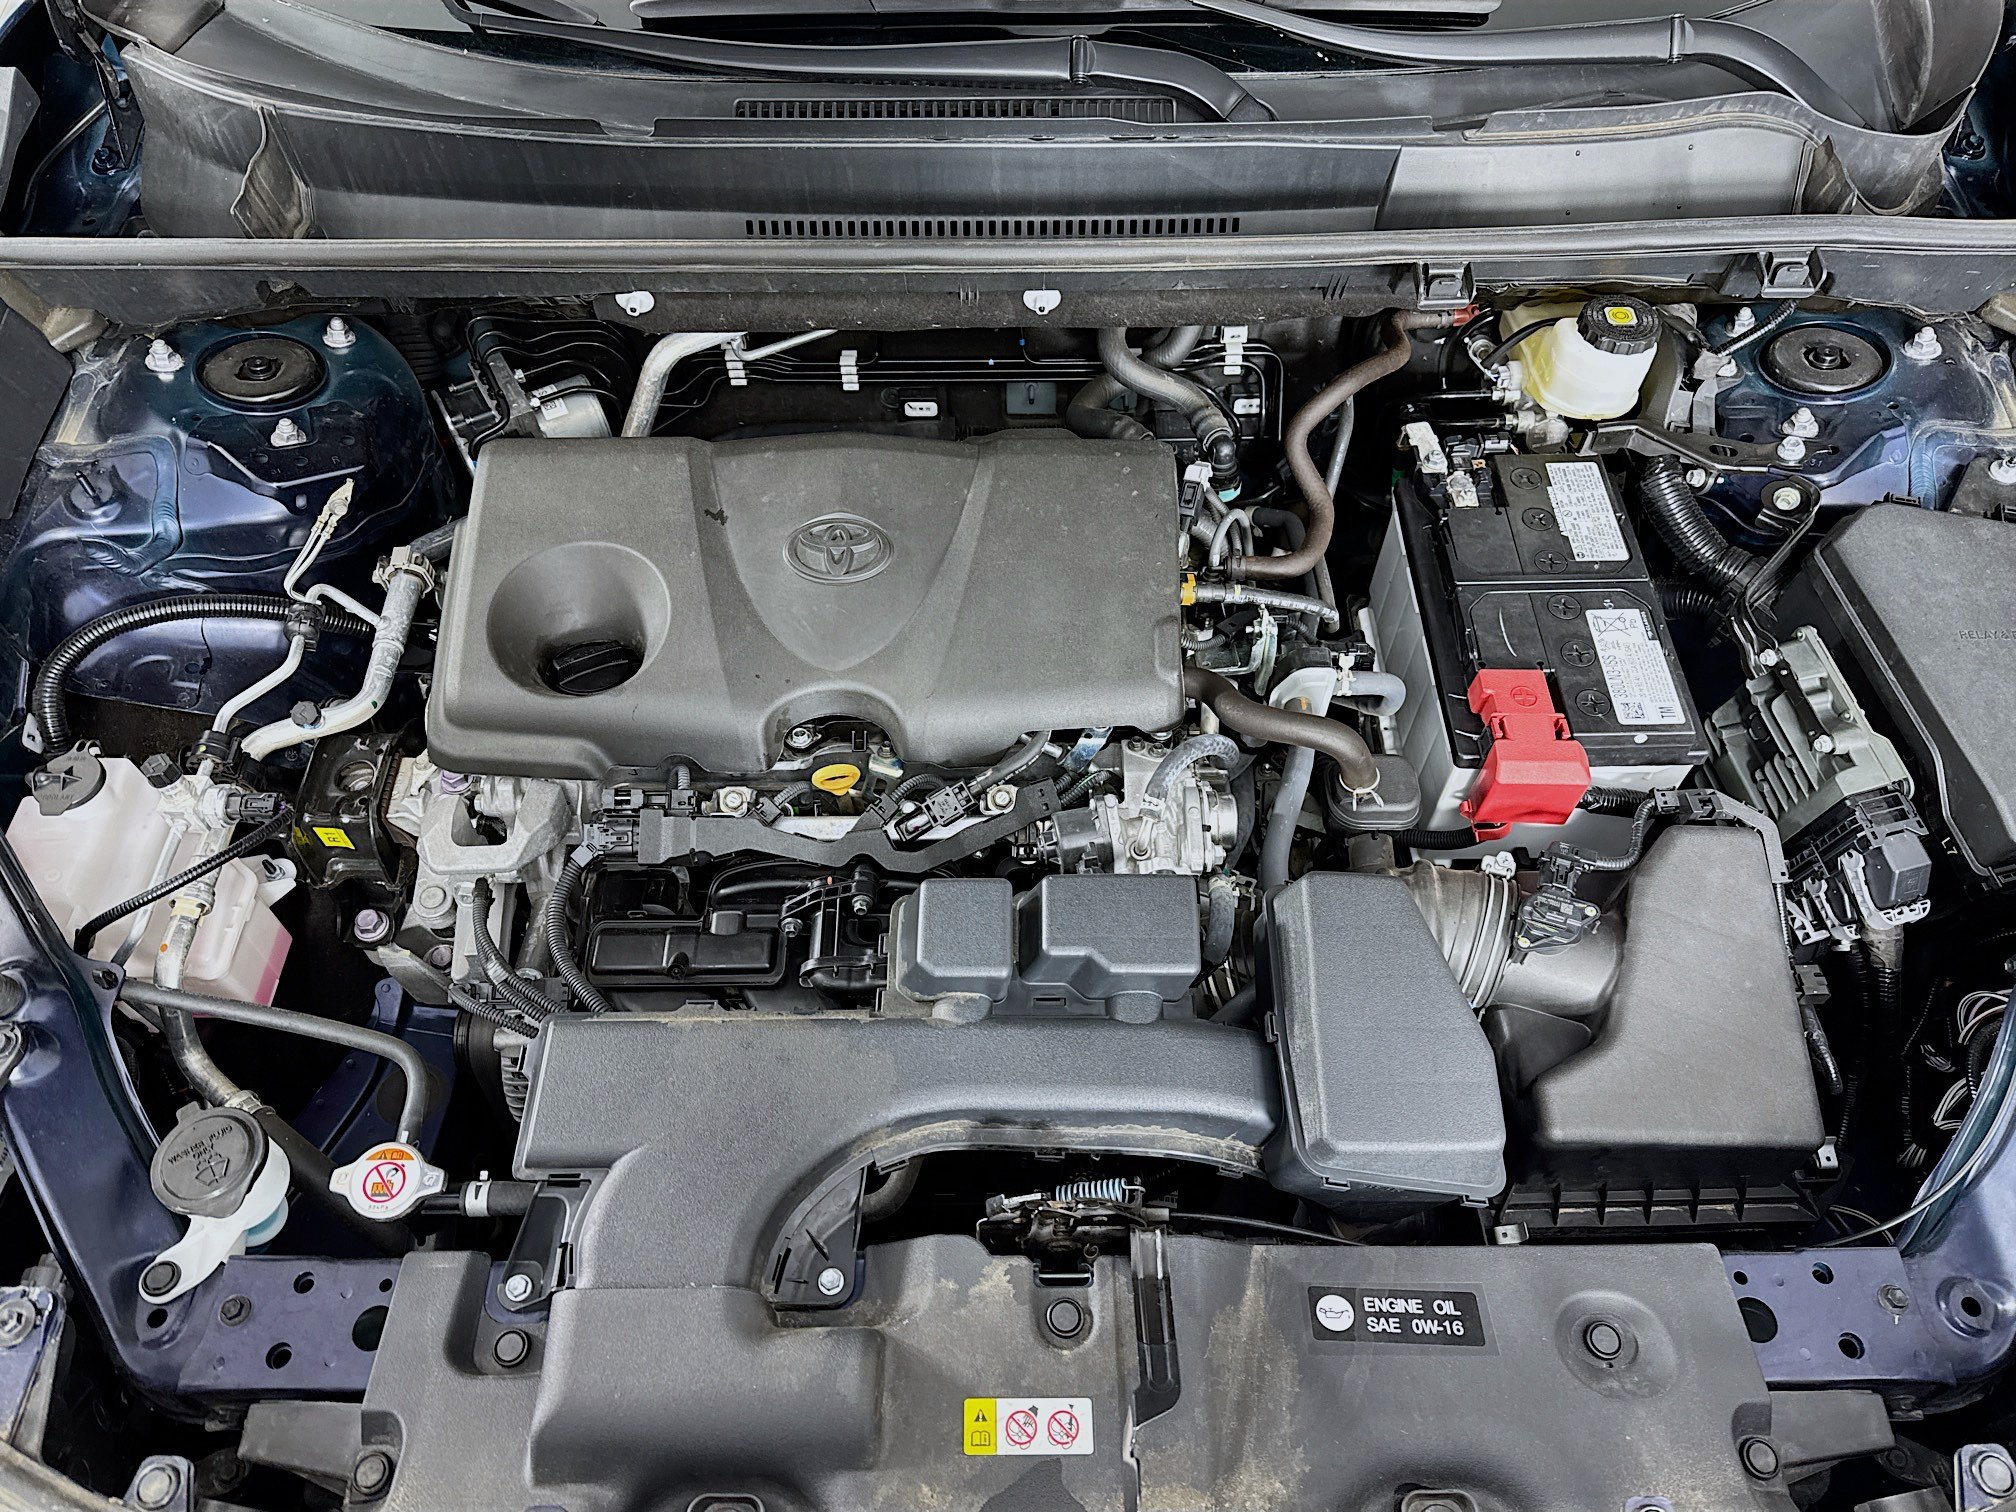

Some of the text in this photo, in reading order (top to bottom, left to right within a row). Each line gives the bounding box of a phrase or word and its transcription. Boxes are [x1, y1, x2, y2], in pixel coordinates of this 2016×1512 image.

[1629, 618, 1639, 630] Pb
[1958, 630, 1998, 640] RELAY
[1658, 706, 1677, 720] TM
[1363, 1296, 1462, 1316] ENGINE OIL
[1366, 1317, 1465, 1336] SAE 0W-16
